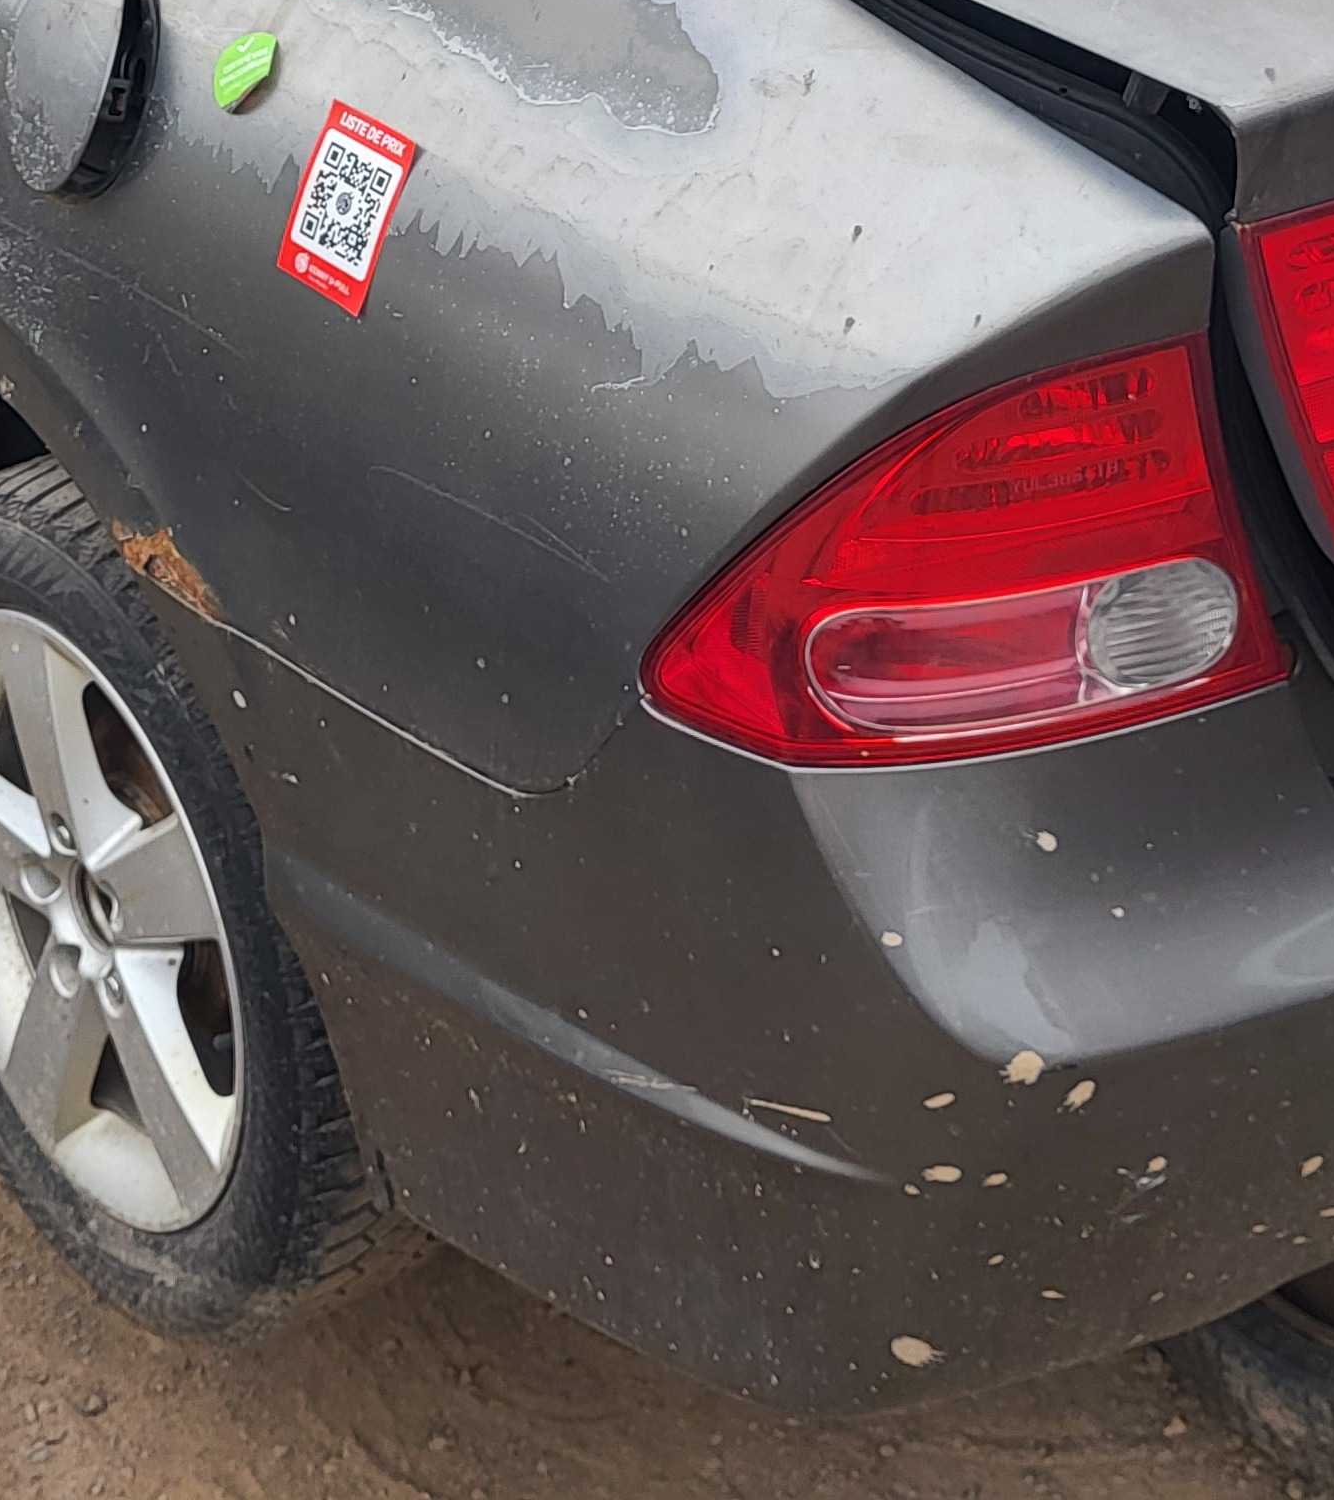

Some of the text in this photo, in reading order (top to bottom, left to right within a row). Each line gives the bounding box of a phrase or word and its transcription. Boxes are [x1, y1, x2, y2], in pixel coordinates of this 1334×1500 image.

[339, 111, 406, 157] LISTE DE PRIX
